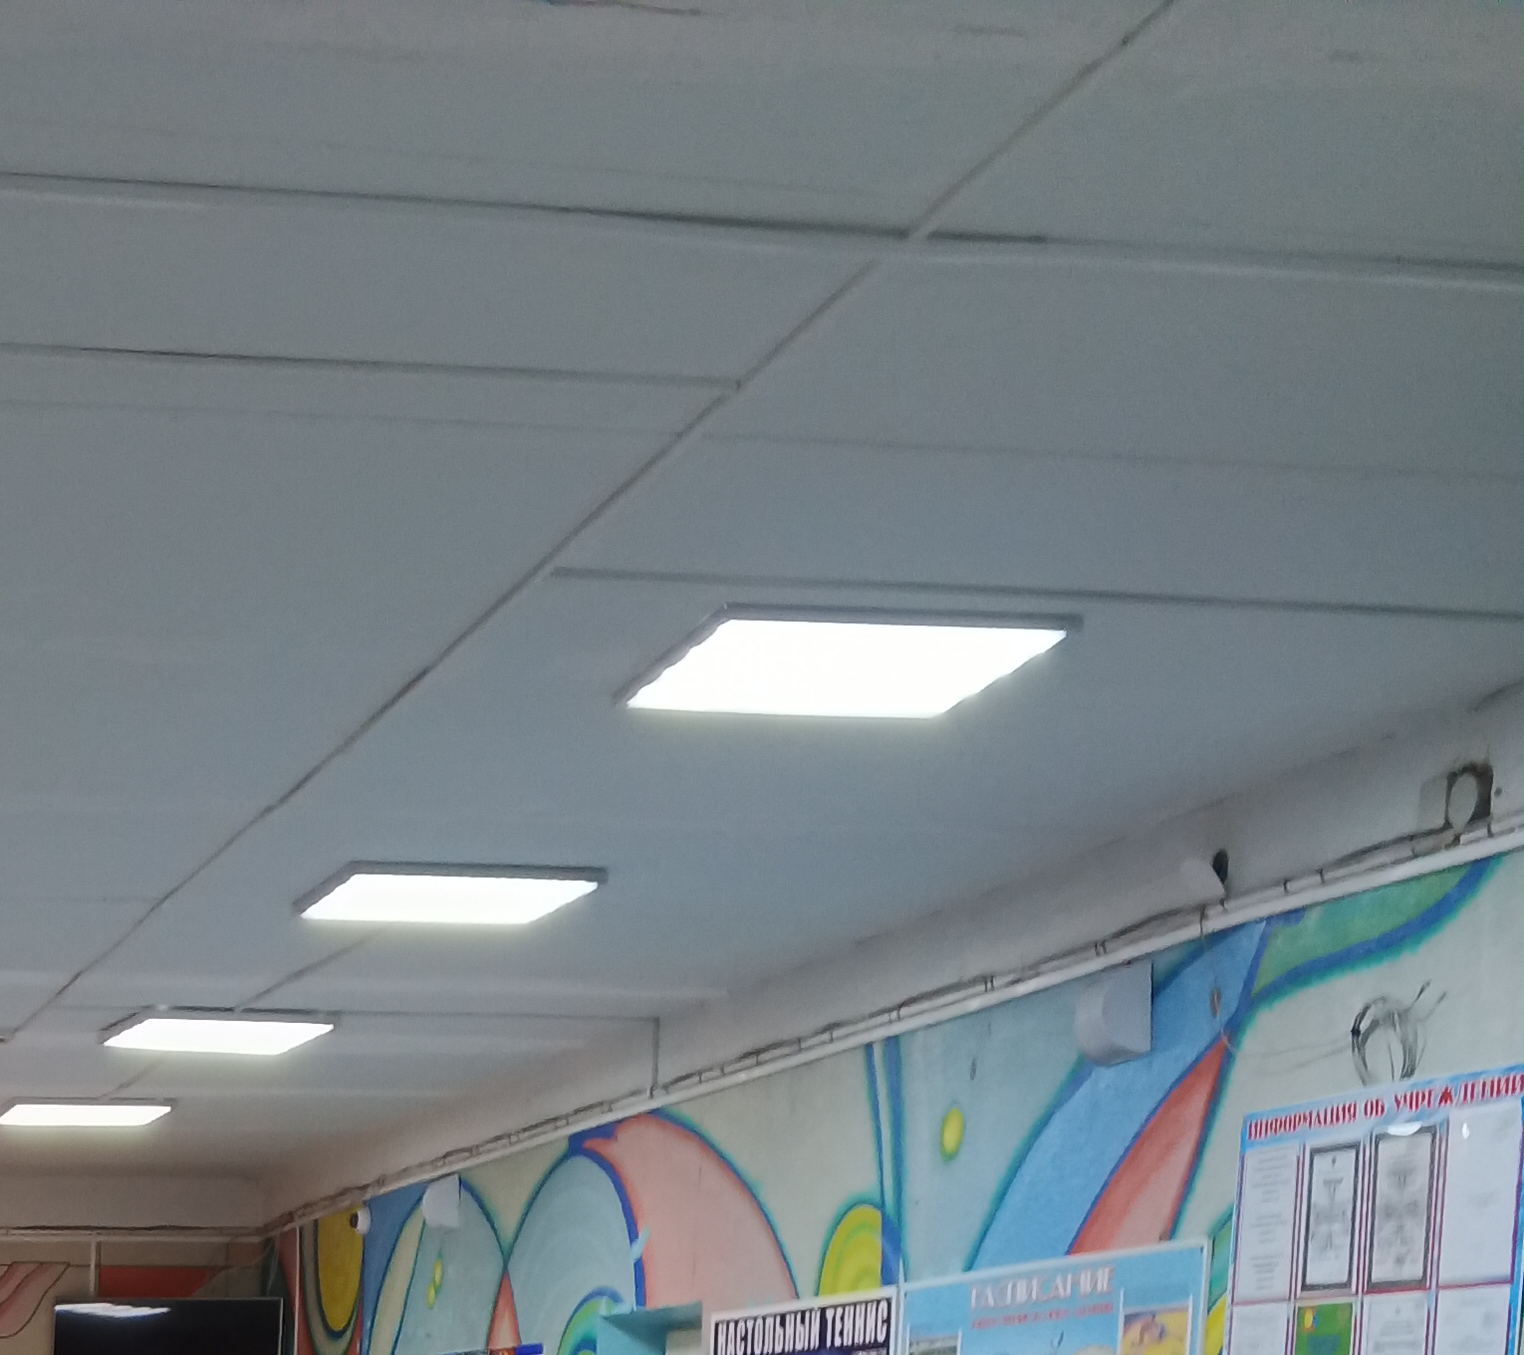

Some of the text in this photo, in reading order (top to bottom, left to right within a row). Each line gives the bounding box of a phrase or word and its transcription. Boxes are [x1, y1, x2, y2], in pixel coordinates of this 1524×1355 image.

[1248, 1101, 1357, 1140] ИНФОРМАЦИЯ
[1364, 1098, 1385, 1118] ОБ
[826, 1299, 888, 1349] ТЕННИС
